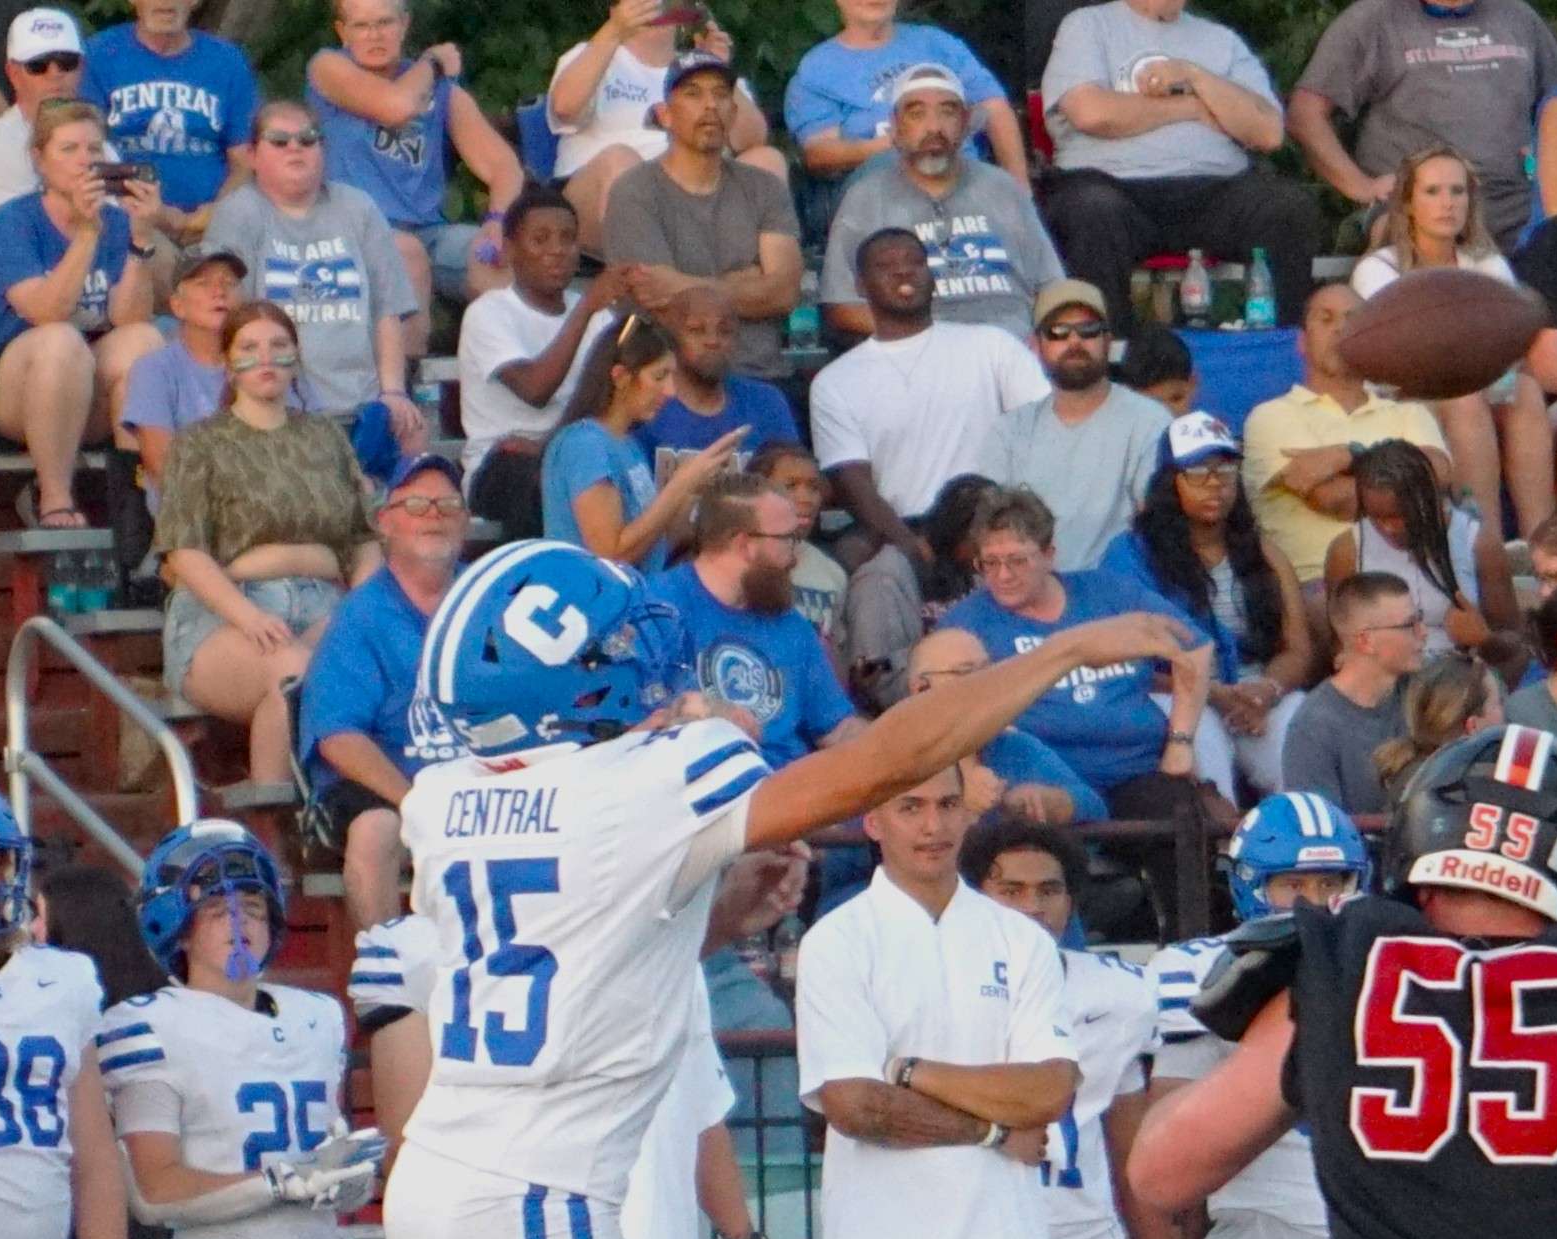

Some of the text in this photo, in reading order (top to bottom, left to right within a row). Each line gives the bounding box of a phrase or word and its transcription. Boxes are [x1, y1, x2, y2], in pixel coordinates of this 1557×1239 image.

[108, 81, 222, 132] CENTRAL
[952, 214, 990, 236] ARE
[273, 238, 347, 262] WE ARE
[931, 275, 1012, 298] ENTRAL
[283, 303, 361, 323] ENTRAL
[502, 583, 589, 667] C
[443, 786, 562, 839] CENTRAL
[1465, 802, 1539, 863] 55
[1439, 856, 1542, 902] Riddell
[441, 855, 562, 1069] 15
[272, 1026, 286, 1043] C
[236, 1080, 329, 1173] 25
